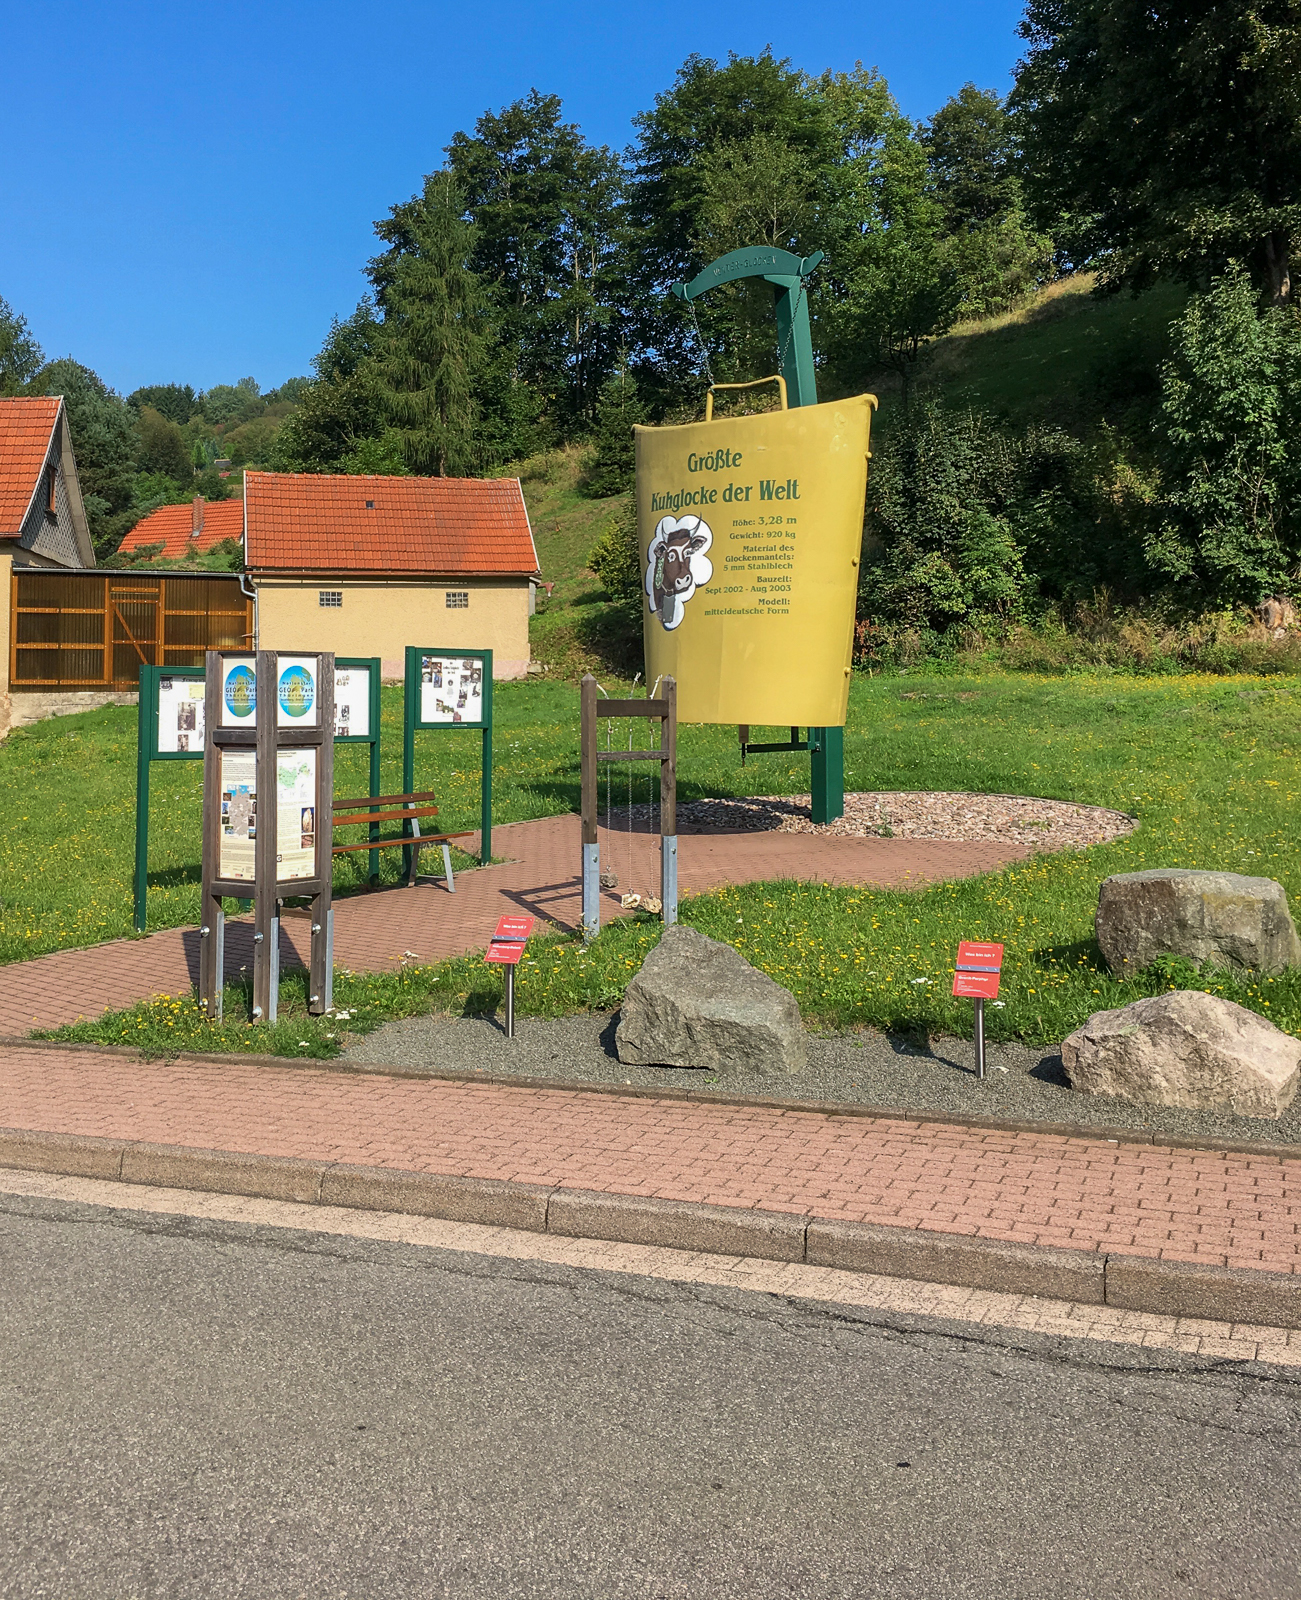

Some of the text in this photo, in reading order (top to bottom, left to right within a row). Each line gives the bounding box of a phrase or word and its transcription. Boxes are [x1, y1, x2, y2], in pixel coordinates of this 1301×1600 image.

[687, 447, 743, 473] Größte
[651, 478, 801, 513] Kuhglocke der Welt
[732, 516, 797, 527] Höhe: 3,28 m
[729, 530, 796, 540] Gewicht: 920 kg
[742, 544, 795, 553] Material des
[725, 554, 795, 563] Glockenmantels:
[723, 562, 793, 572] 5 mm Stahlblech
[756, 575, 792, 584] Bauzeit:
[704, 586, 722, 596] Sept
[723, 585, 744, 594] 2002
[750, 584, 768, 594] Aug
[769, 584, 792, 593] 2003
[758, 597, 791, 606] Modell:
[704, 606, 789, 617] mitteldeutsche Form
